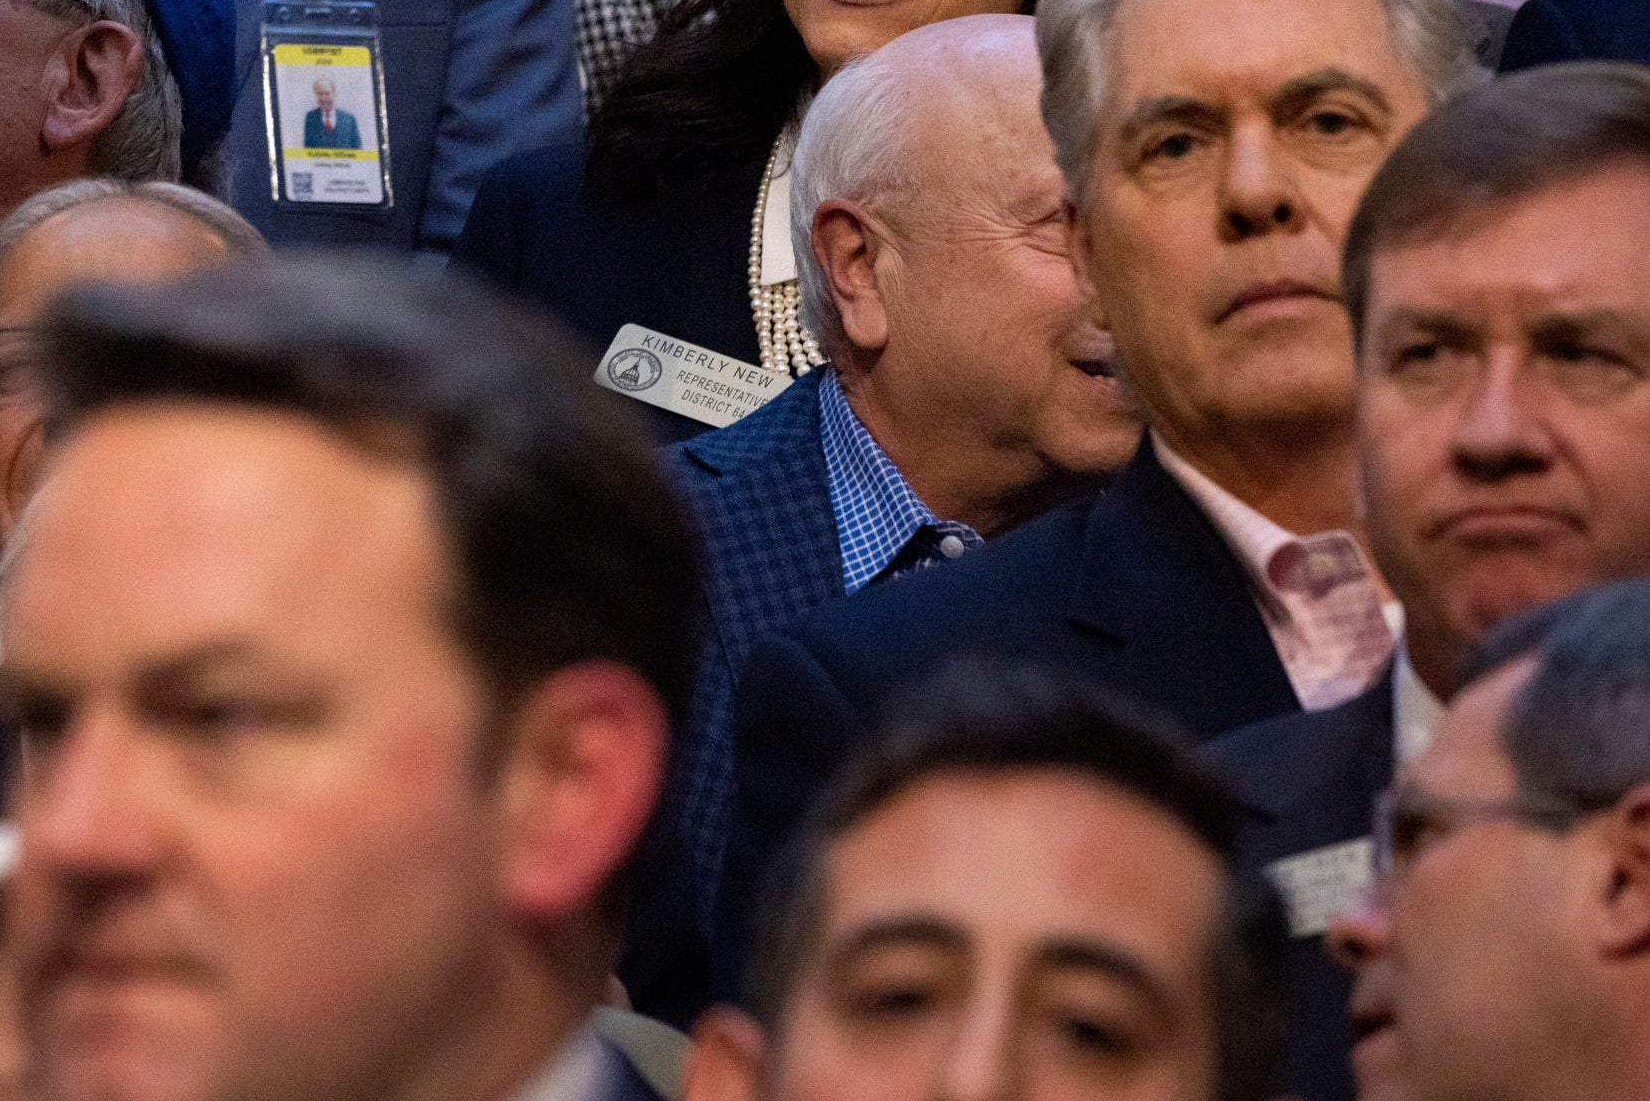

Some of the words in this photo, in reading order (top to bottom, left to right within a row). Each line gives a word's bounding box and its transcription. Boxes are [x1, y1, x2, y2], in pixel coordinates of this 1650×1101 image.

[641, 334, 730, 373] KIMBERLY
[733, 366, 775, 389] NEW
[676, 370, 769, 407] REPRESENTATIVE
[681, 389, 732, 415] DISTRICT
[732, 407, 746, 419] 64
